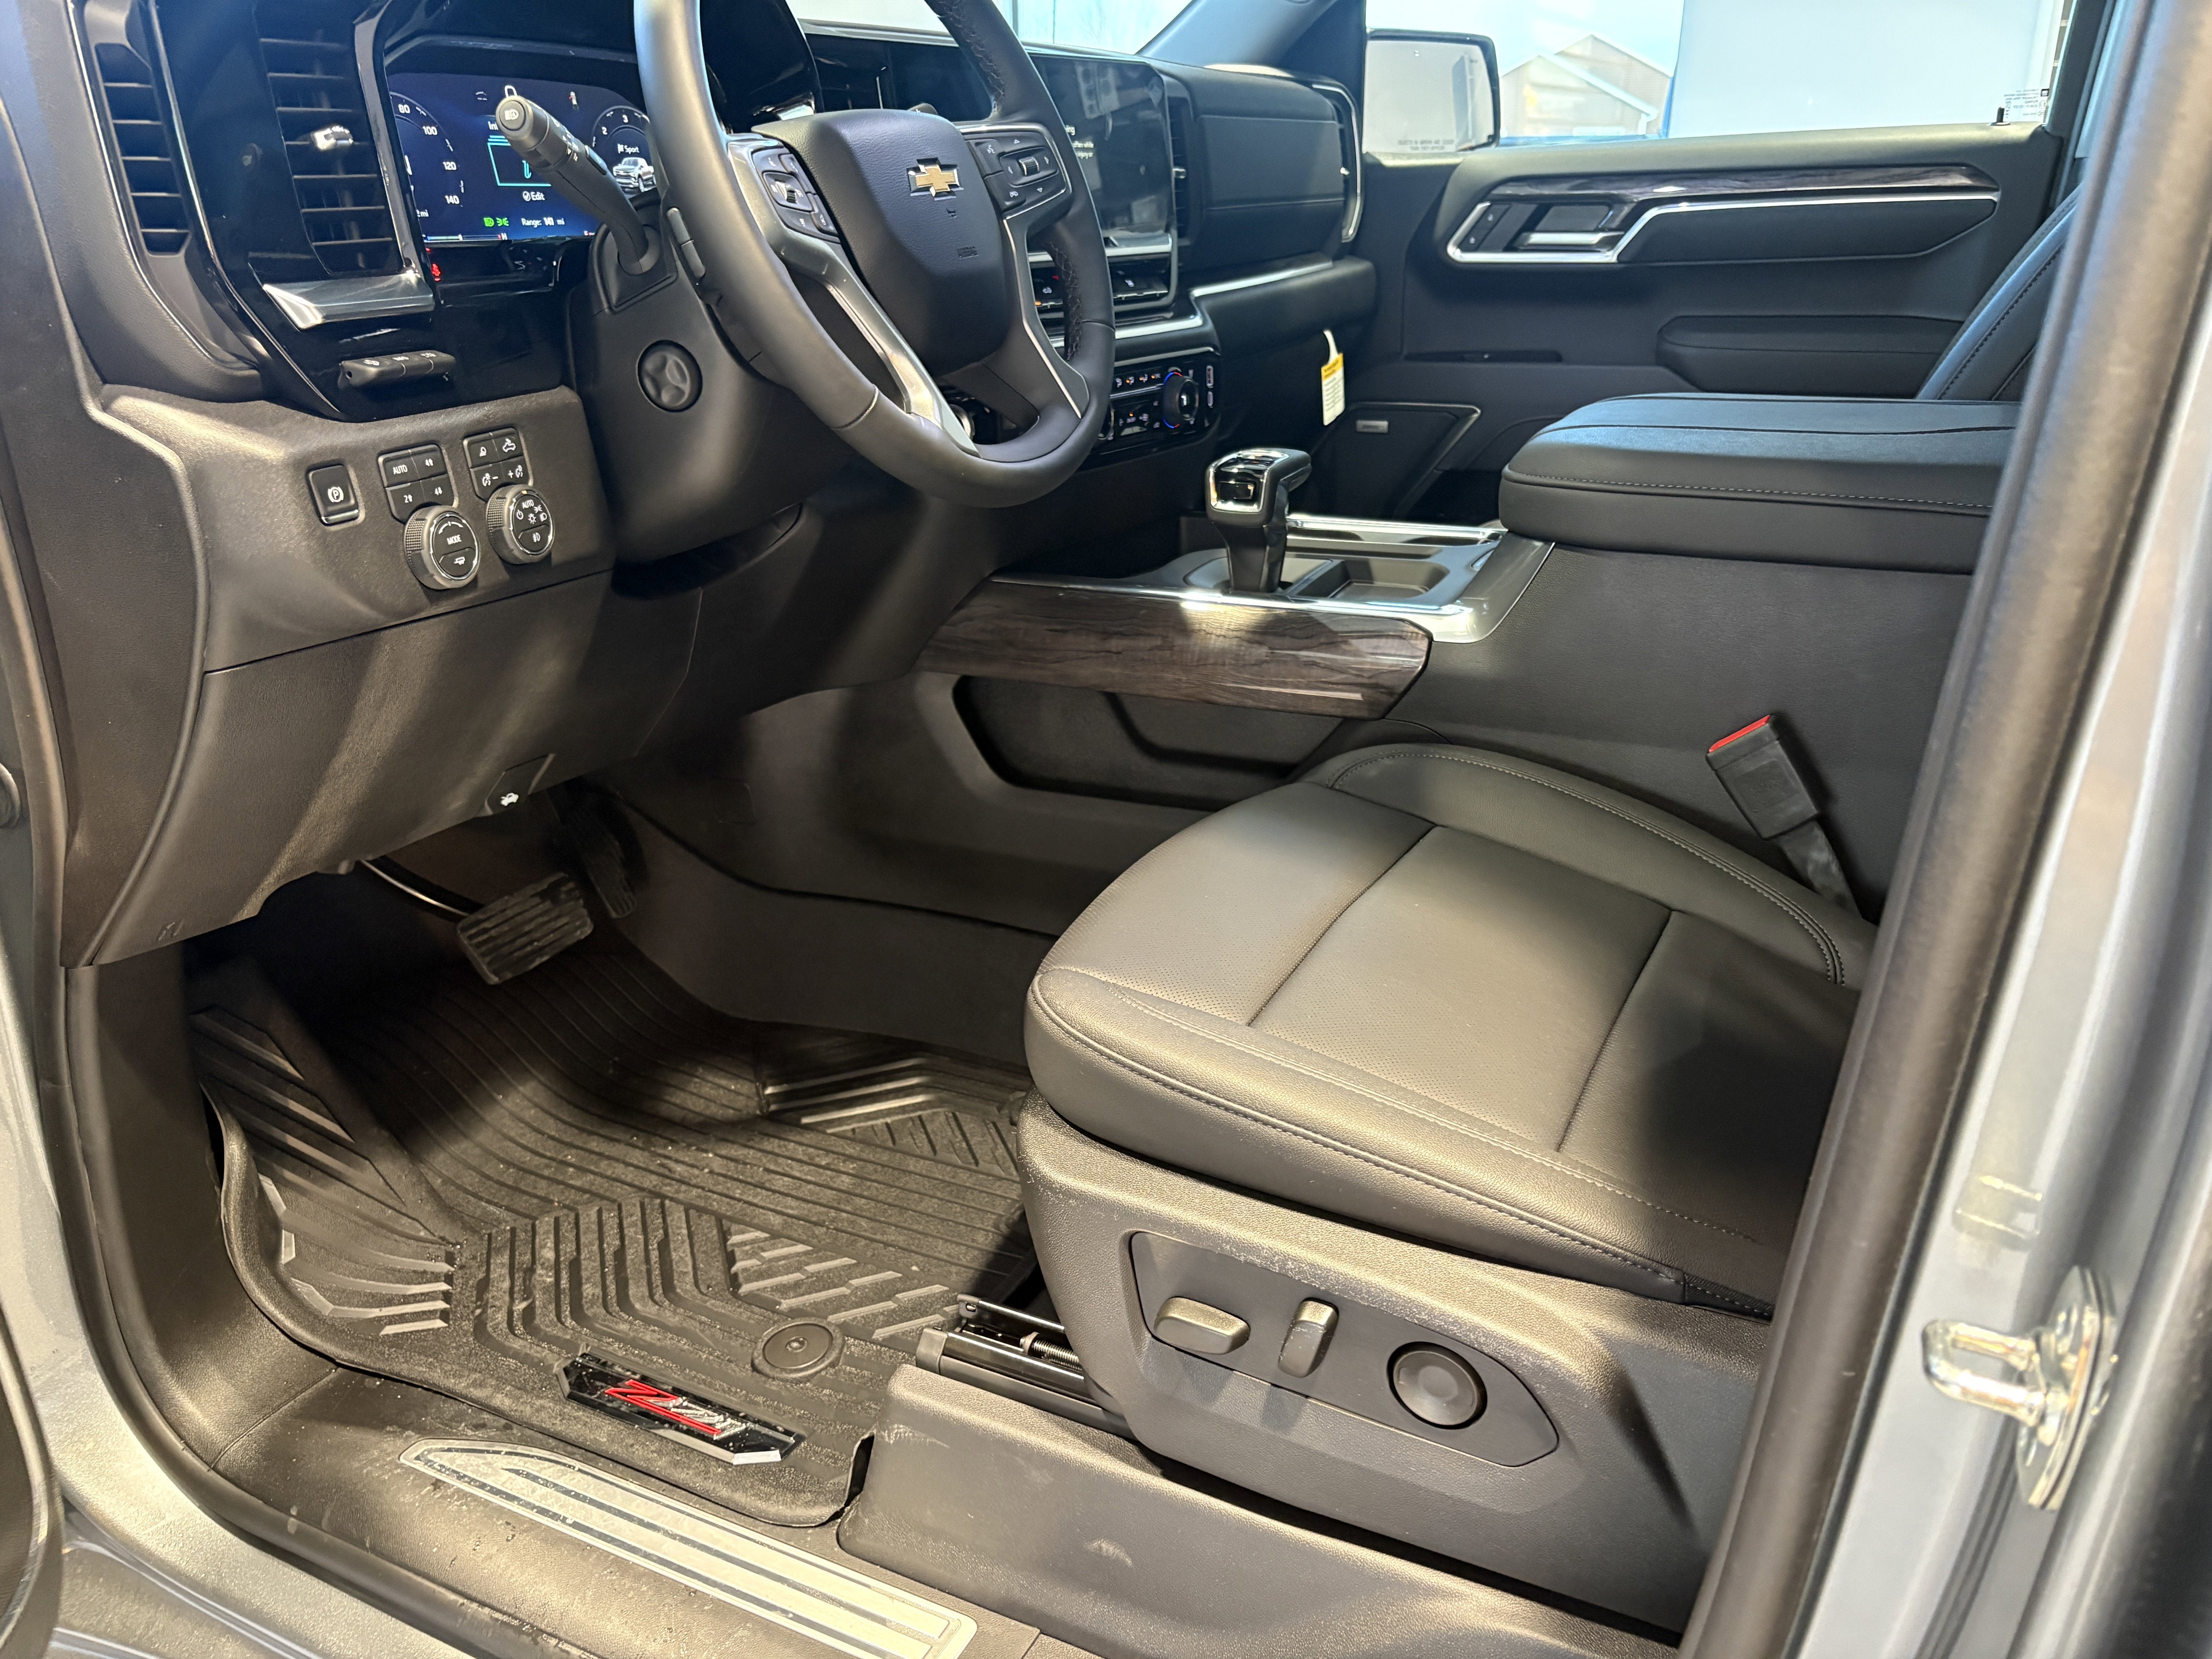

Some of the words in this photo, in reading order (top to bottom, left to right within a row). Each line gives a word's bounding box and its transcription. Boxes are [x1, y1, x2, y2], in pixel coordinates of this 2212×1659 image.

[398, 104, 410, 113] 80
[622, 115, 629, 123] 3
[422, 126, 438, 135] 100
[602, 126, 608, 135] 2
[624, 145, 640, 154] Sport
[443, 161, 457, 170] 120
[445, 195, 460, 204] 140
[530, 192, 545, 201] Edit
[521, 218, 542, 228] Range:
[393, 464, 408, 475] AUTO
[522, 499, 534, 509] AUTO
[447, 534, 462, 545] MODE
